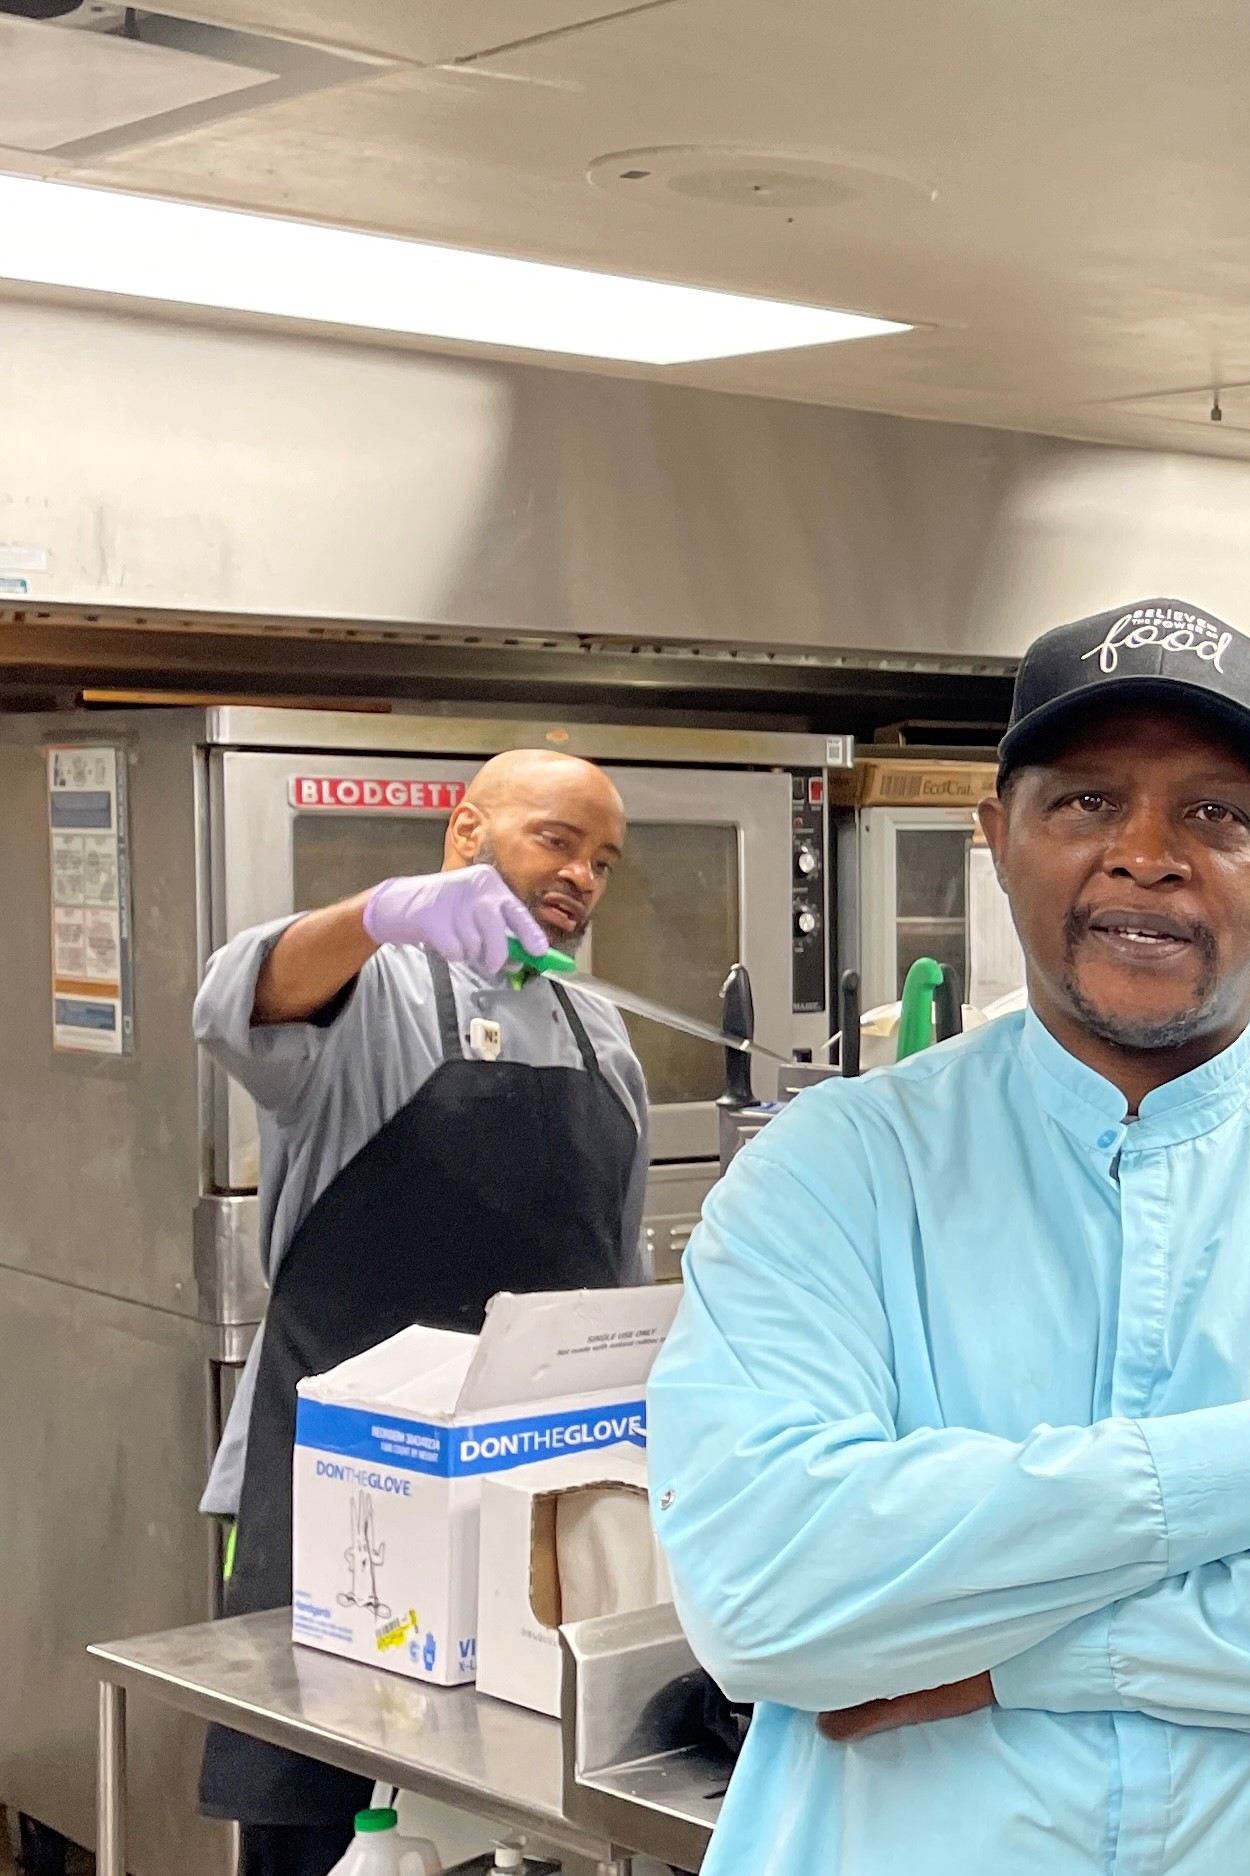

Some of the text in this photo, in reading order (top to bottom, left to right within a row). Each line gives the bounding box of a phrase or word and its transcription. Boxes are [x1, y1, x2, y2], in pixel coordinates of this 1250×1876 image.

[1132, 608, 1207, 629] BELIEVE
[1153, 618, 1204, 635] POWER
[1081, 613, 1233, 674] food
[301, 779, 461, 806] BLODGETT
[459, 1415, 642, 1463] DONTHEGLOVE
[316, 1459, 412, 1496] DONTHEGLOVE
